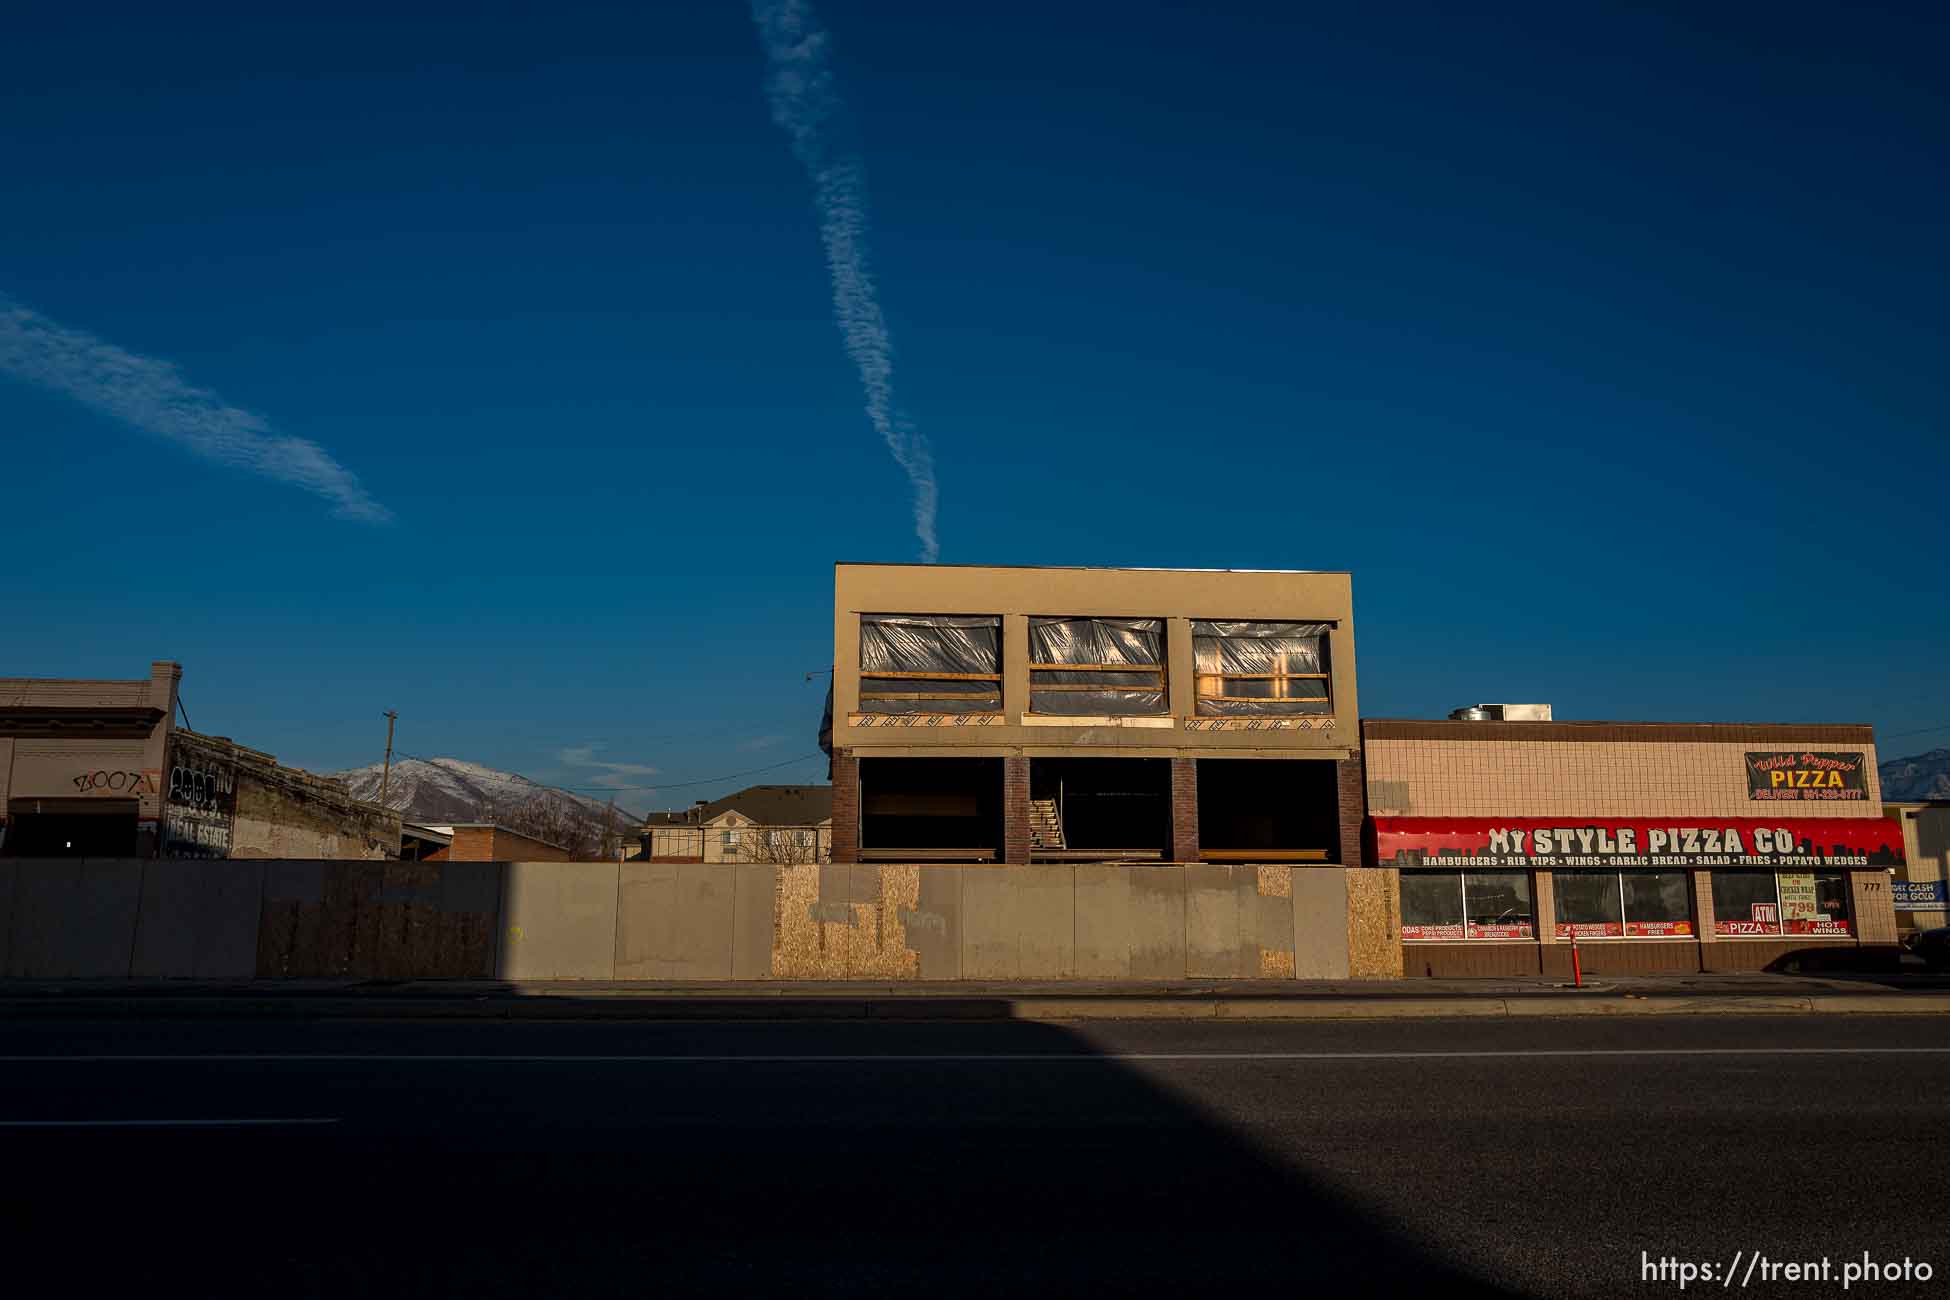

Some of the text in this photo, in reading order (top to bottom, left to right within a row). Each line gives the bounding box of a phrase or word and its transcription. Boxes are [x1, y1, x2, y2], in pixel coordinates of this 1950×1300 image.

[1754, 753, 1857, 772] Wild Pepper
[1771, 770, 1843, 788] PIZZA
[1755, 788, 1798, 800] DELIVERY
[197, 823, 229, 849] ESTATE
[1488, 827, 1805, 854] MY STYLE PIZZA CO.
[1423, 856, 1868, 866] HAMBURGERS RIB TIPS WINGS GARLIC BREAD SALAD FRIES POTATO WEDGES
[1864, 882, 1881, 892] 777
[1908, 883, 1934, 892] CASH
[1910, 892, 1935, 901] GOLD
[1755, 906, 1774, 922] ATM
[1639, 922, 1674, 930] HAMBURGERS
[1730, 923, 1764, 934] PIZZA
